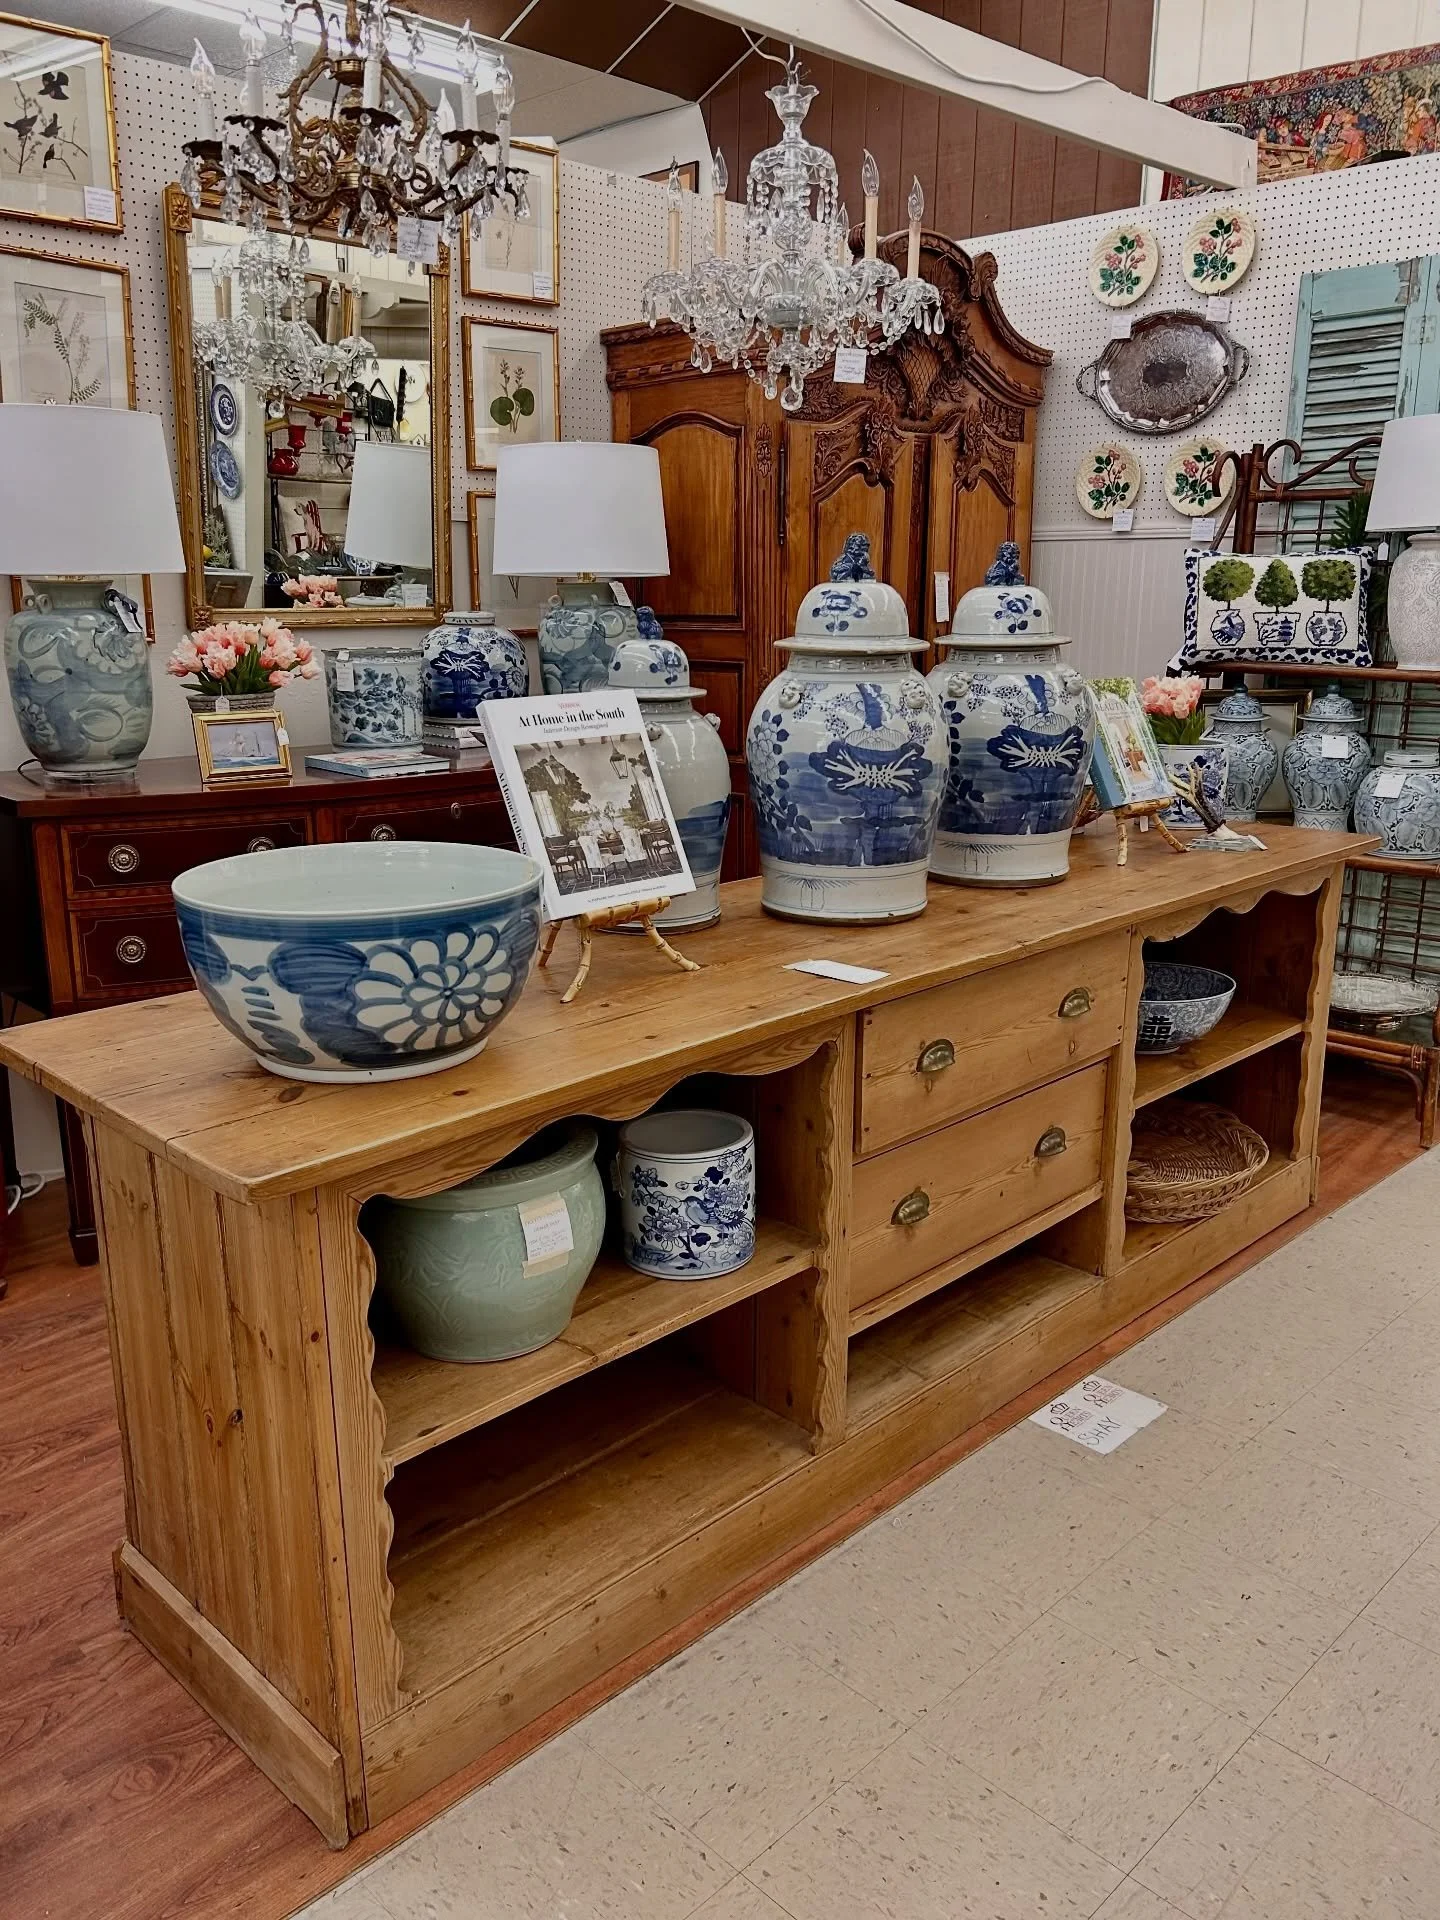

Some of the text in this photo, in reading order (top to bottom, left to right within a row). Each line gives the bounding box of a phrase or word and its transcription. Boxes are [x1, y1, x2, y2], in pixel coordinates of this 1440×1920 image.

[519, 707, 625, 728] At Home in the South
[502, 784, 514, 813] Home
[511, 814, 518, 825] in
[514, 825, 523, 841] the
[1077, 1415, 1121, 1446] SHAY
